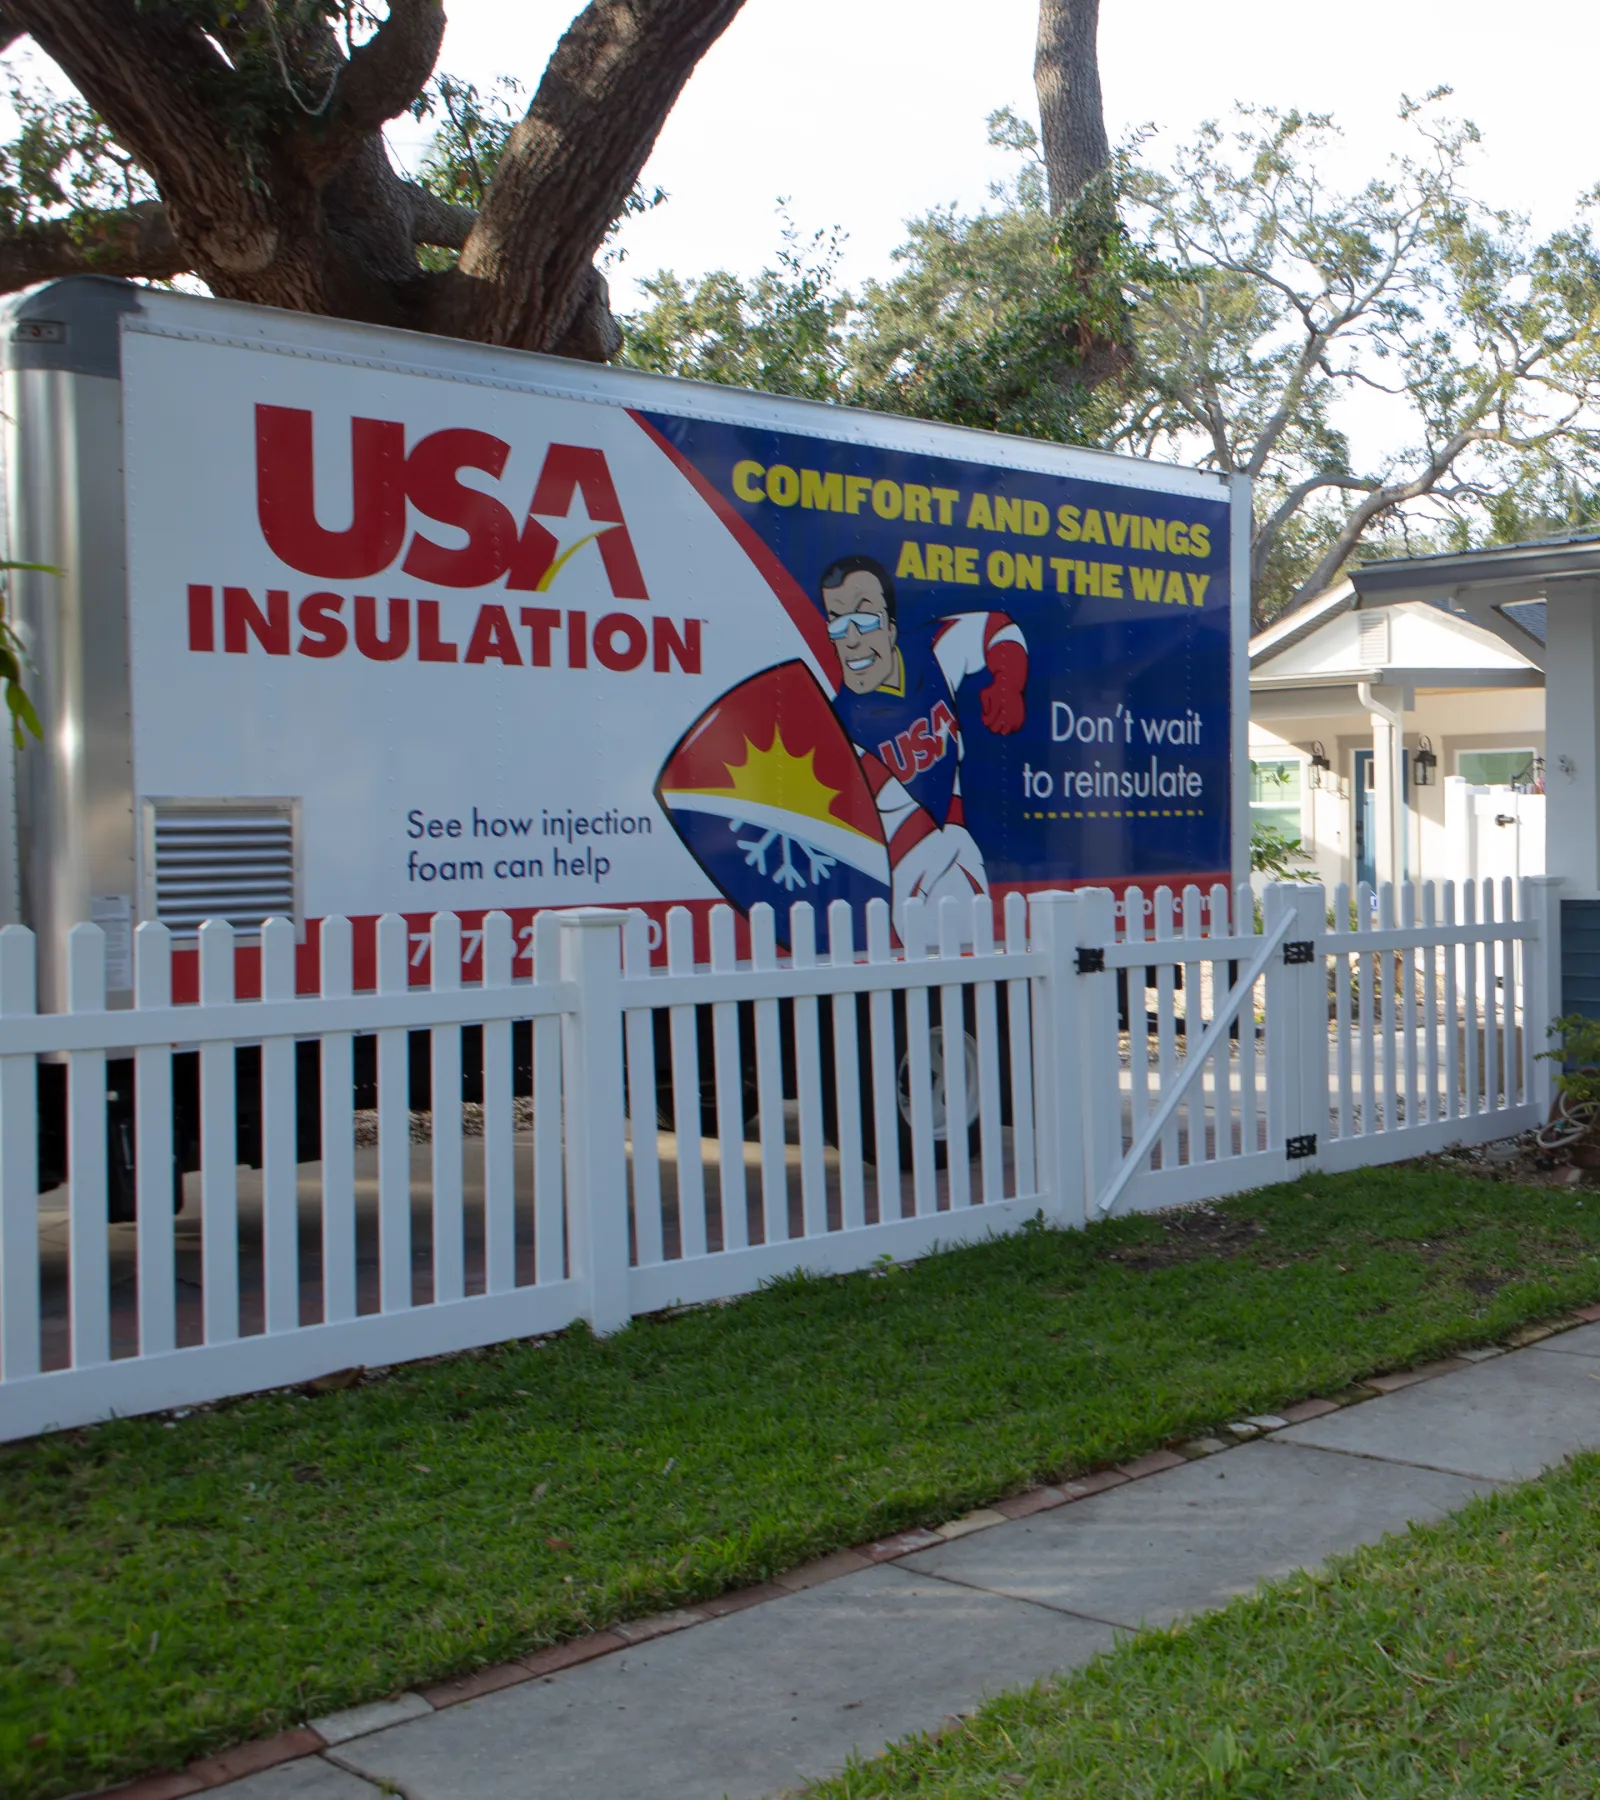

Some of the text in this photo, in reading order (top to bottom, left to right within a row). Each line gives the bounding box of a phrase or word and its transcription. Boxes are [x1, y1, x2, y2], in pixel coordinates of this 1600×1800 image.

[254, 403, 649, 600] USA
[732, 460, 1211, 557] COMFORT AND SAVINGS
[895, 541, 1211, 607] ARE ON THE WAY
[187, 583, 702, 674] INSULATION
[877, 699, 959, 785] USA
[1051, 700, 1203, 746] Don't wait
[1022, 754, 1203, 799] to reinsulate
[406, 806, 652, 844] See how injection
[407, 845, 611, 884] foam can help
